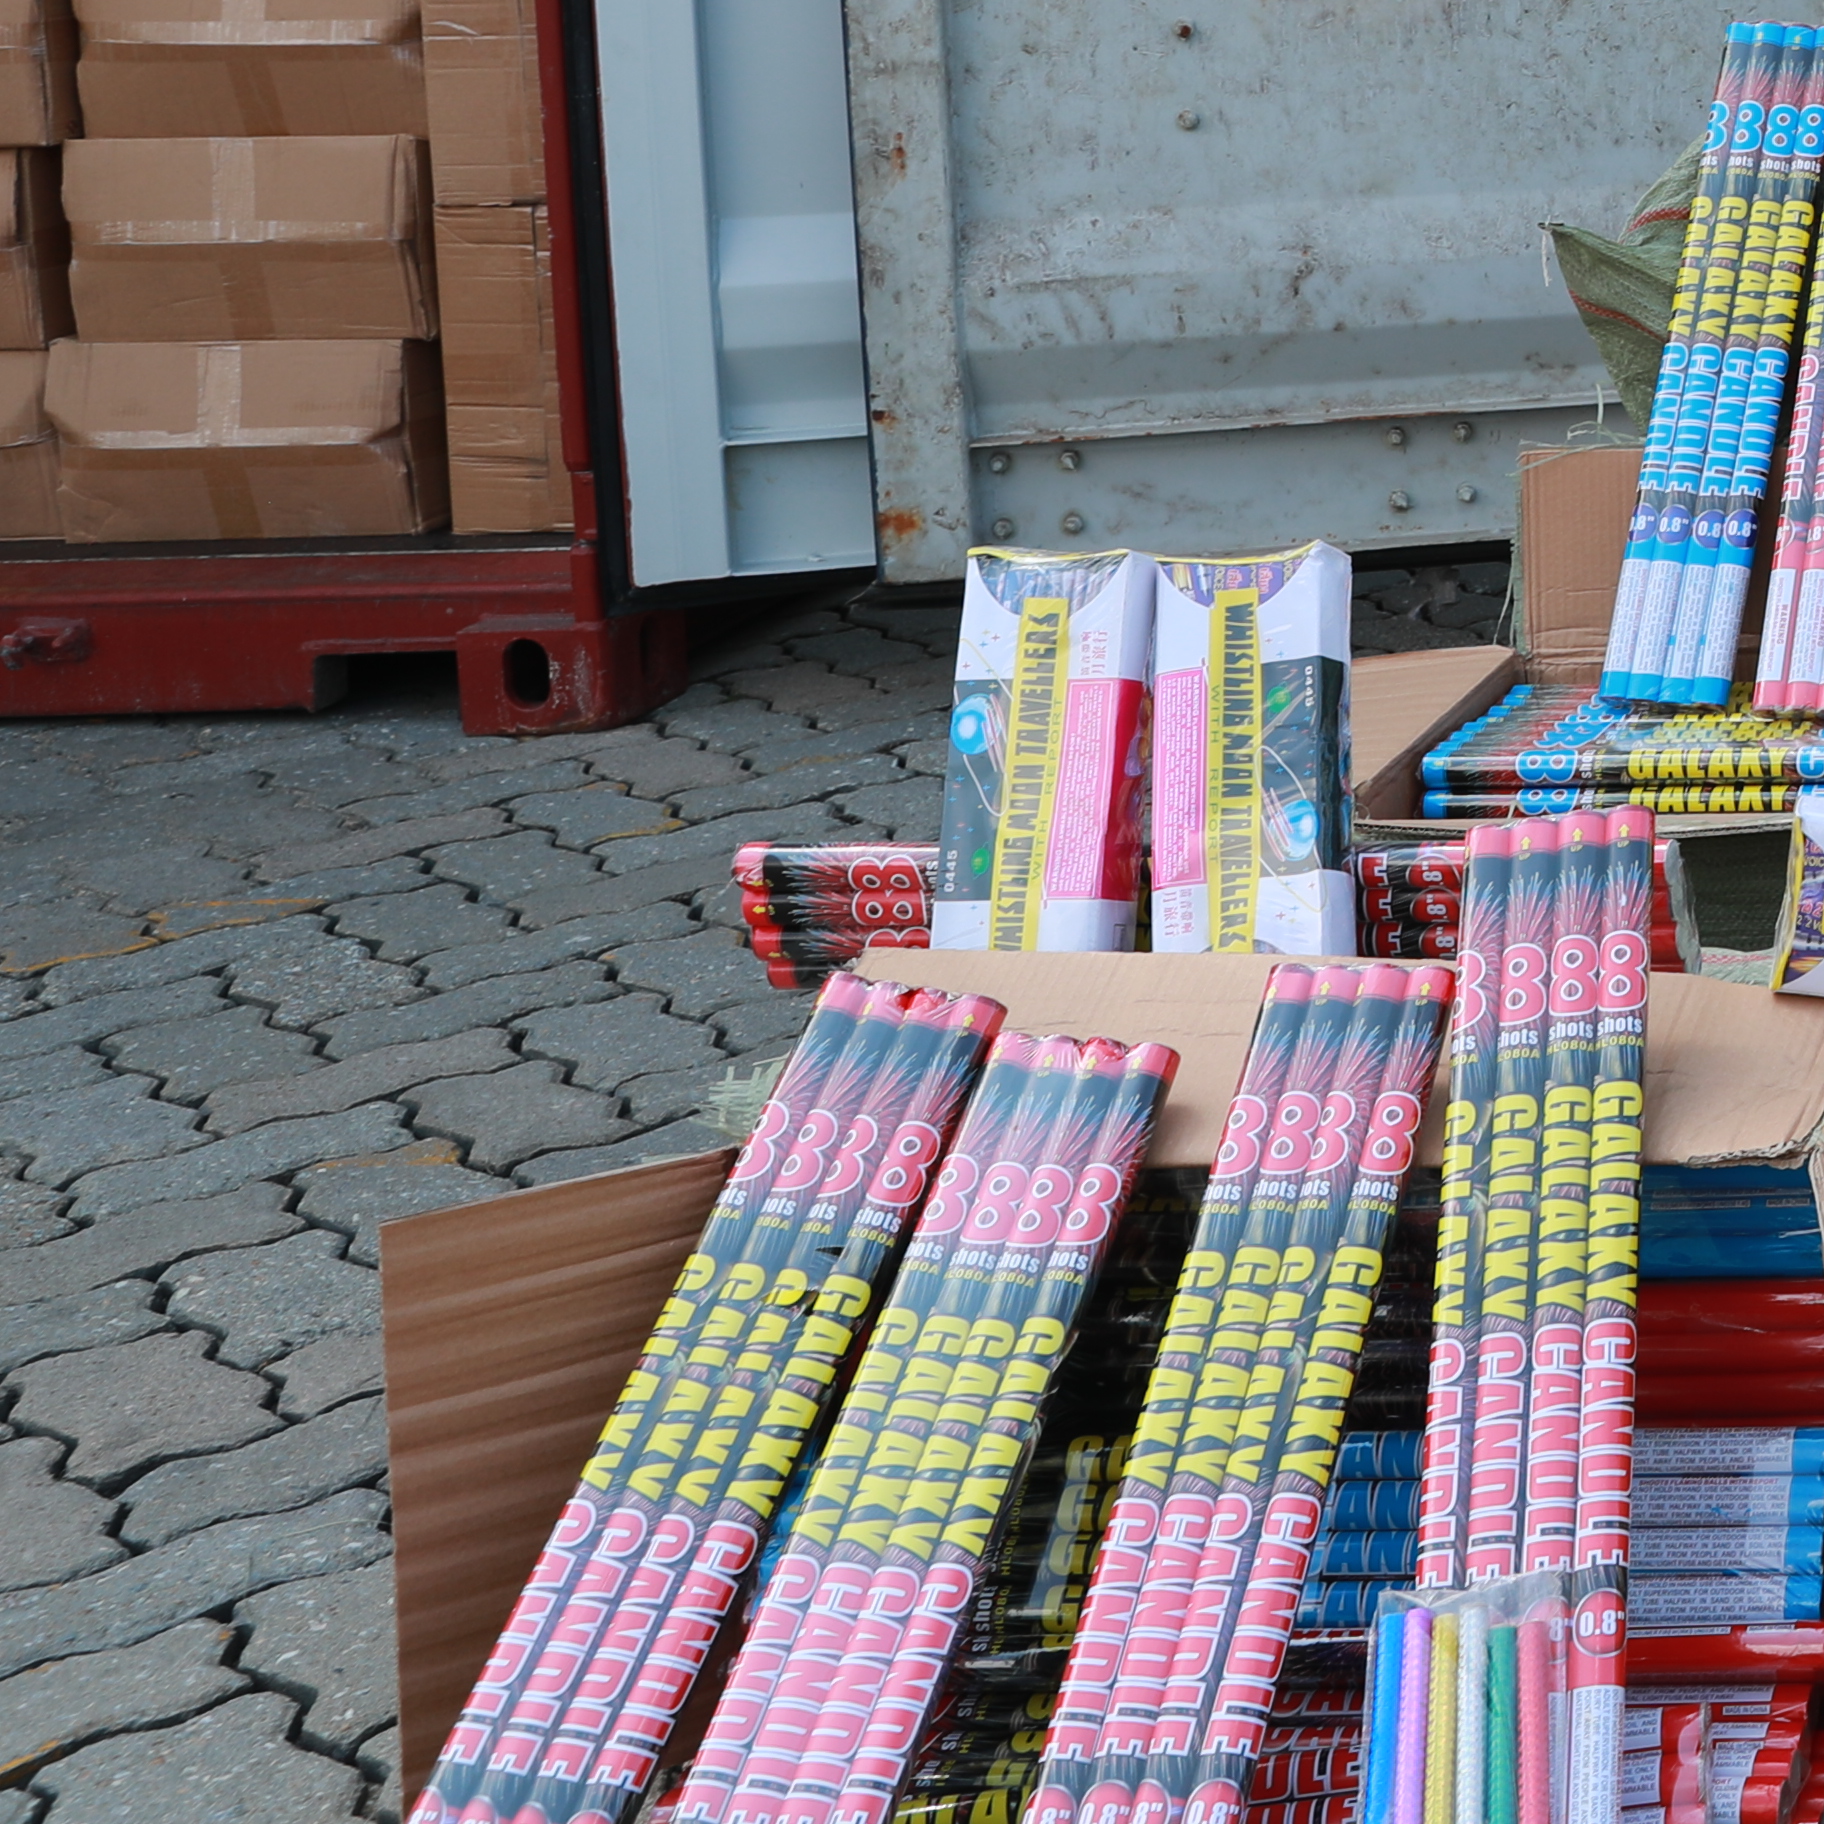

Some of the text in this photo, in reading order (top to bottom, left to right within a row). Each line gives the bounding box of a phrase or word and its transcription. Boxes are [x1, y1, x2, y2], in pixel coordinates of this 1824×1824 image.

[1206, 684, 1220, 866] WITH REPORT
[1627, 747, 1791, 782] GALAXY
[1597, 929, 1649, 1013] 8
[1597, 1014, 1644, 1037] shots
[1572, 1080, 1644, 1637] GALAXY CANDLE 0.8"
